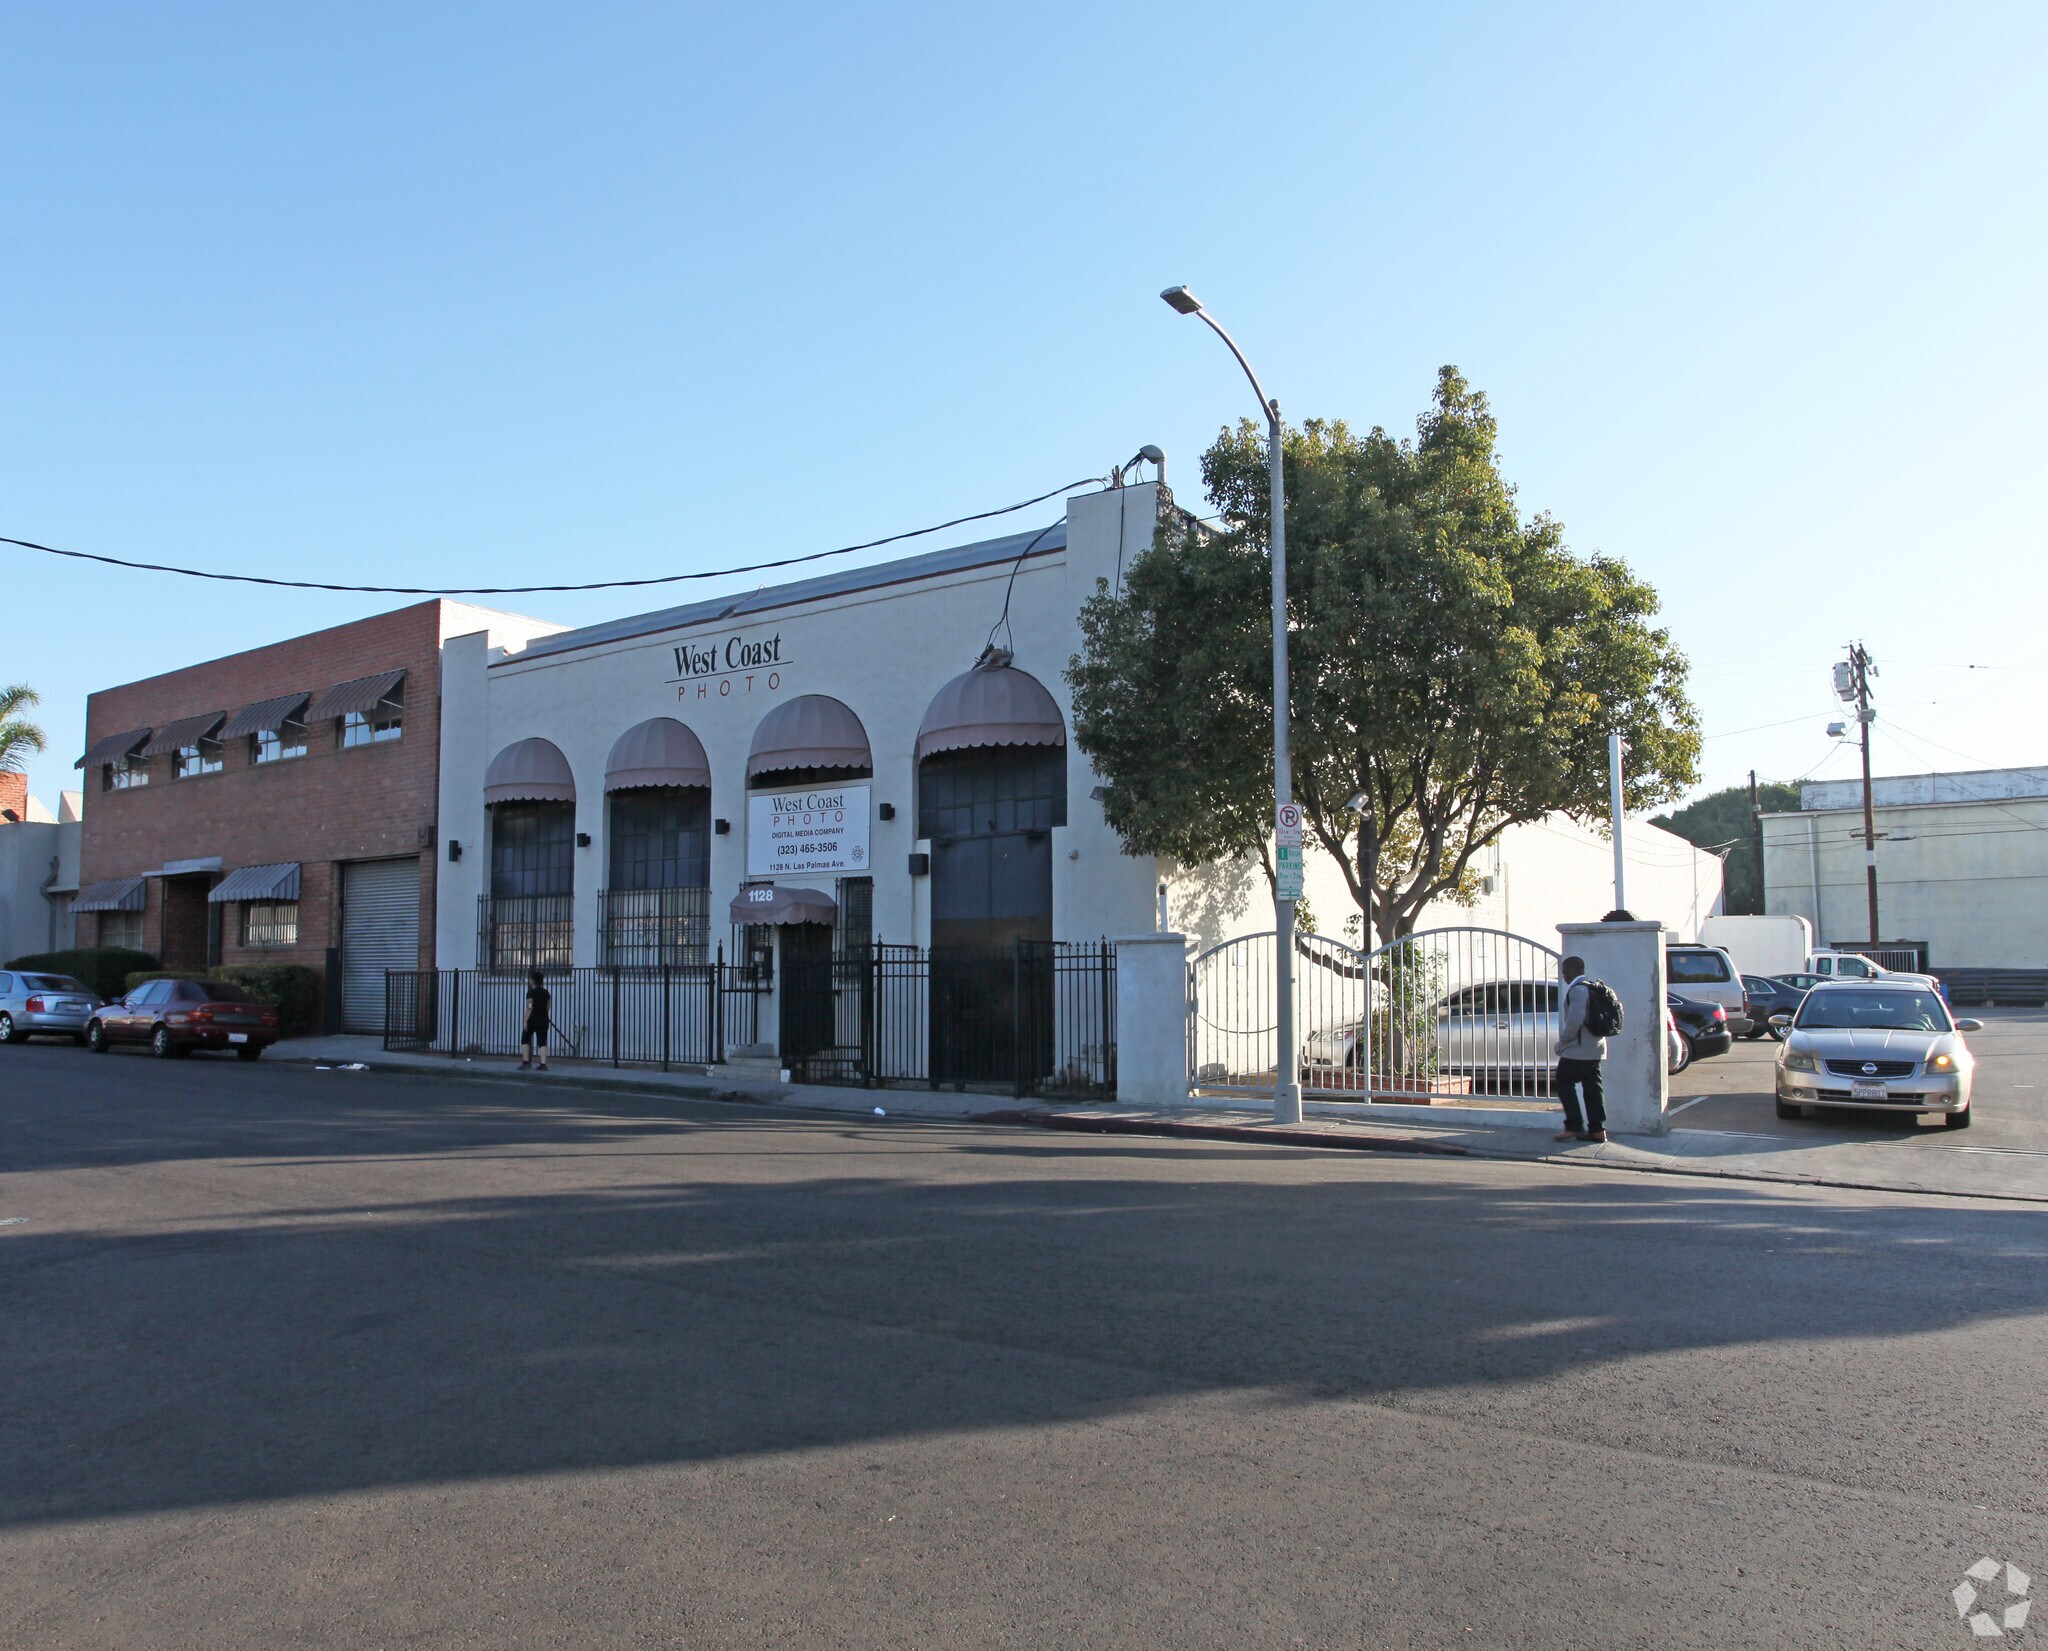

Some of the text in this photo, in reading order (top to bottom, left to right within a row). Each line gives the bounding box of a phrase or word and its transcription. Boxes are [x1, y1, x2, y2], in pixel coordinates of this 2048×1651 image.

[673, 632, 781, 677] West Coast
[678, 672, 780, 702] PHOTO
[773, 793, 844, 813] West Coast
[773, 811, 844, 827] PHOTO
[772, 827, 844, 839] DIGITAL MEDIA COMPANY
[777, 842, 838, 857] (323) 465-3506
[769, 863, 784, 871] 1128
[806, 861, 830, 869] Palmas
[831, 860, 846, 868] Ave.
[748, 889, 774, 902] 1128
